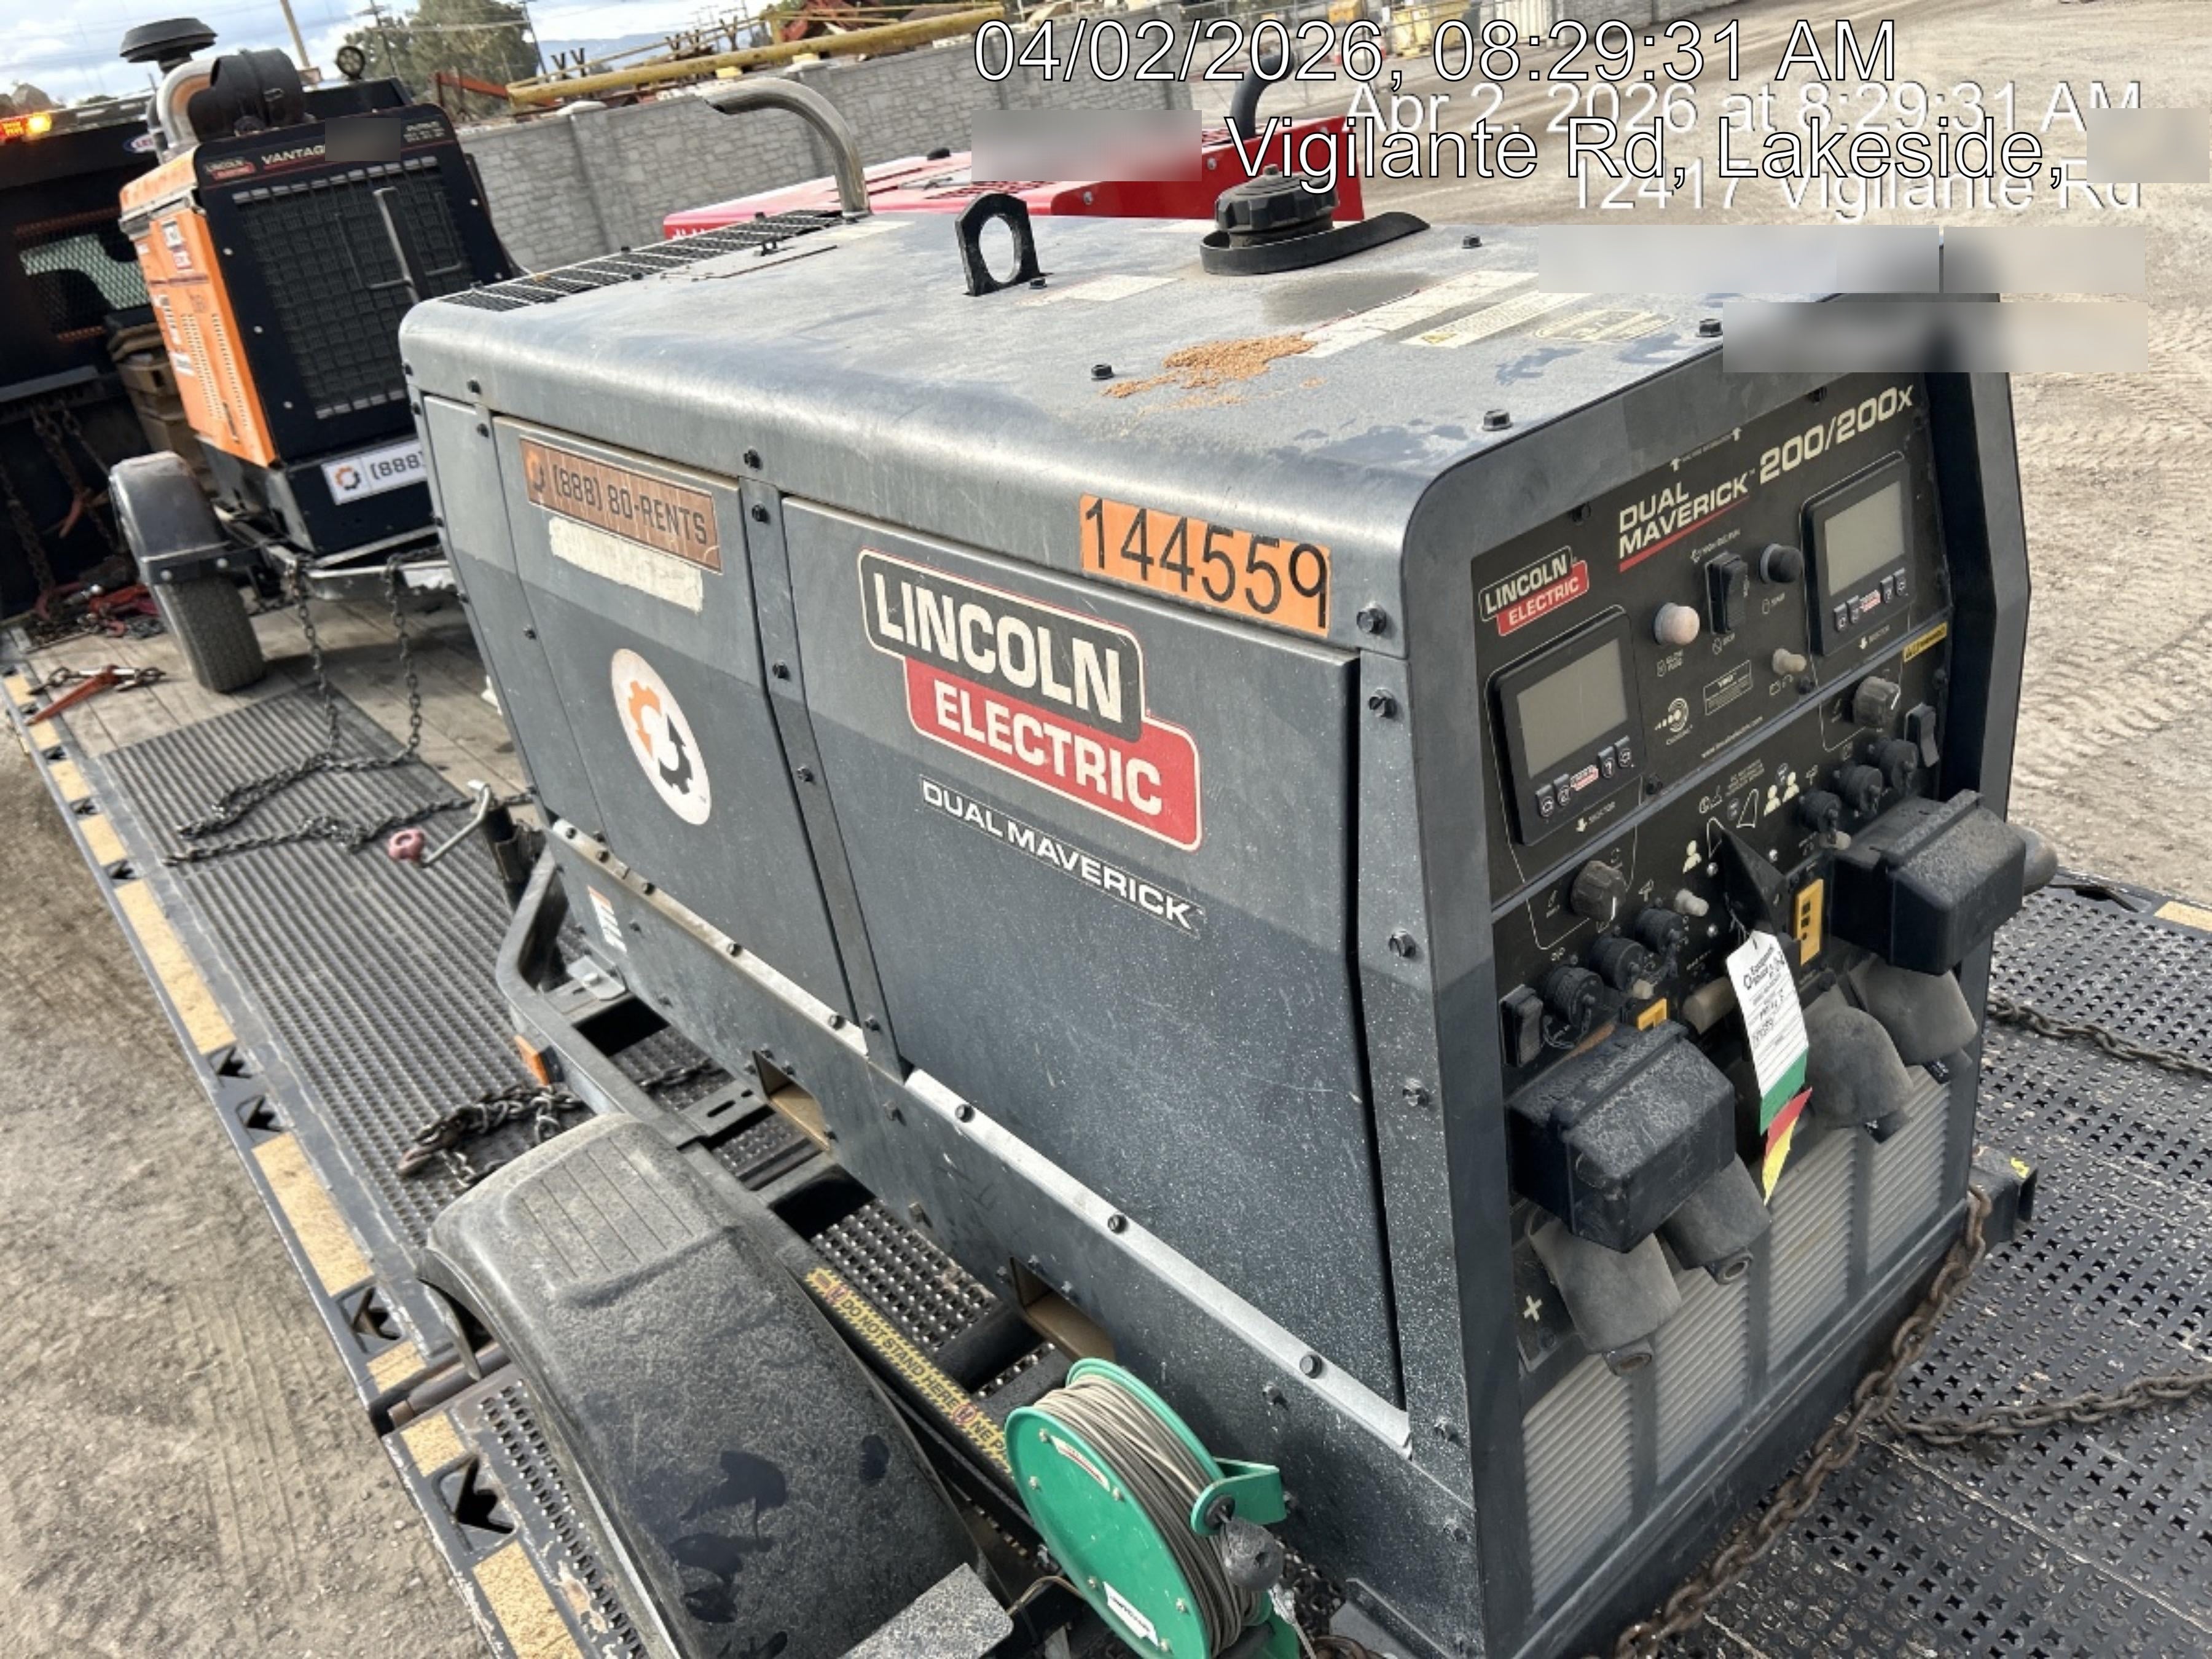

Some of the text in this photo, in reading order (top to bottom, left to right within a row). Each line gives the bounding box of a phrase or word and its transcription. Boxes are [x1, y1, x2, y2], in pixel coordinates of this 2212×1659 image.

[261, 144, 326, 164] VANTAG
[1760, 385, 1913, 485] 200/200x
[554, 465, 707, 544] (888) 80-RENTS
[1620, 481, 1689, 533] DUAL
[1620, 472, 1748, 559] MAVERICK
[1085, 498, 1327, 629] 144559
[1485, 554, 1567, 614] LINCOLN
[1509, 576, 1579, 626] ELECTRIC
[874, 573, 1123, 723] LINCOLN
[933, 679, 1163, 816] ELECTRIC
[923, 780, 1193, 930] DUAL MAVERICK
[841, 1300, 960, 1411] DO NOT STAND HERE
